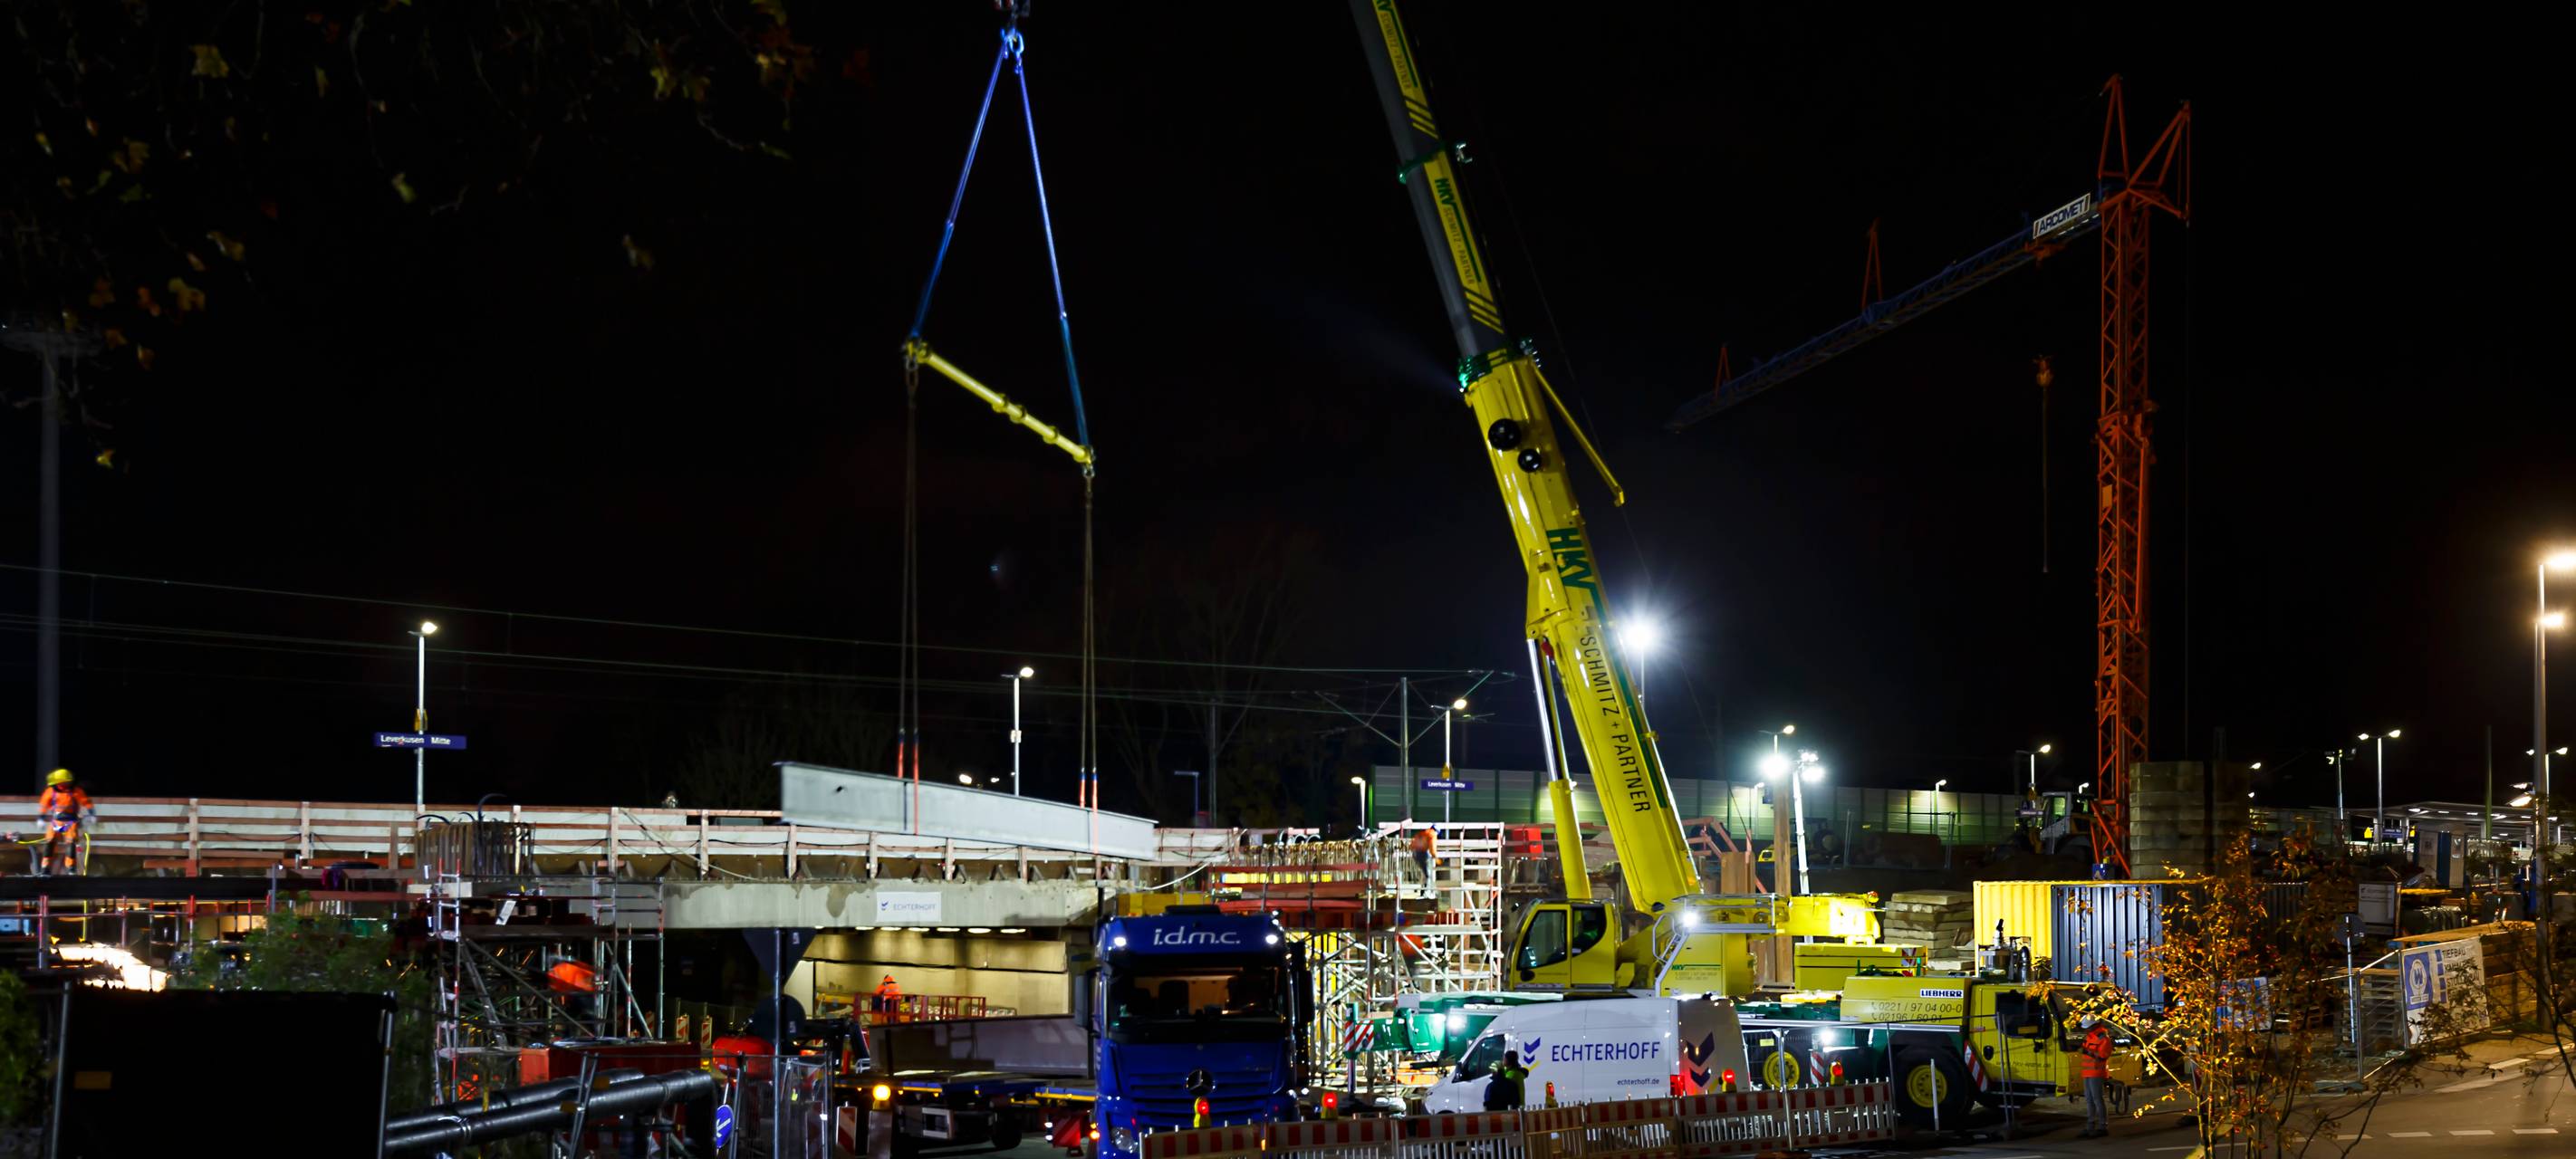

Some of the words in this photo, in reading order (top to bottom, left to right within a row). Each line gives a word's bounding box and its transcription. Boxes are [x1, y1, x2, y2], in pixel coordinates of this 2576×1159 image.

[1435, 179, 1455, 204] HKV
[2039, 199, 2084, 234] ARCOMET
[1547, 528, 1595, 589] HKV
[1580, 637, 1620, 715] SCHMITZ
[1611, 721, 1620, 729] +
[380, 734, 424, 743] Leverkusen
[1612, 734, 1650, 811] PARTNER
[1154, 925, 1241, 945] i.d.m.c.
[2442, 948, 2465, 959] TIEFBAU
[1879, 1001, 1900, 1011] 0221
[1911, 1002, 1922, 1011] 97
[1925, 1003, 1937, 1012] 04
[1552, 1041, 1660, 1062] ECHTERHOFF
